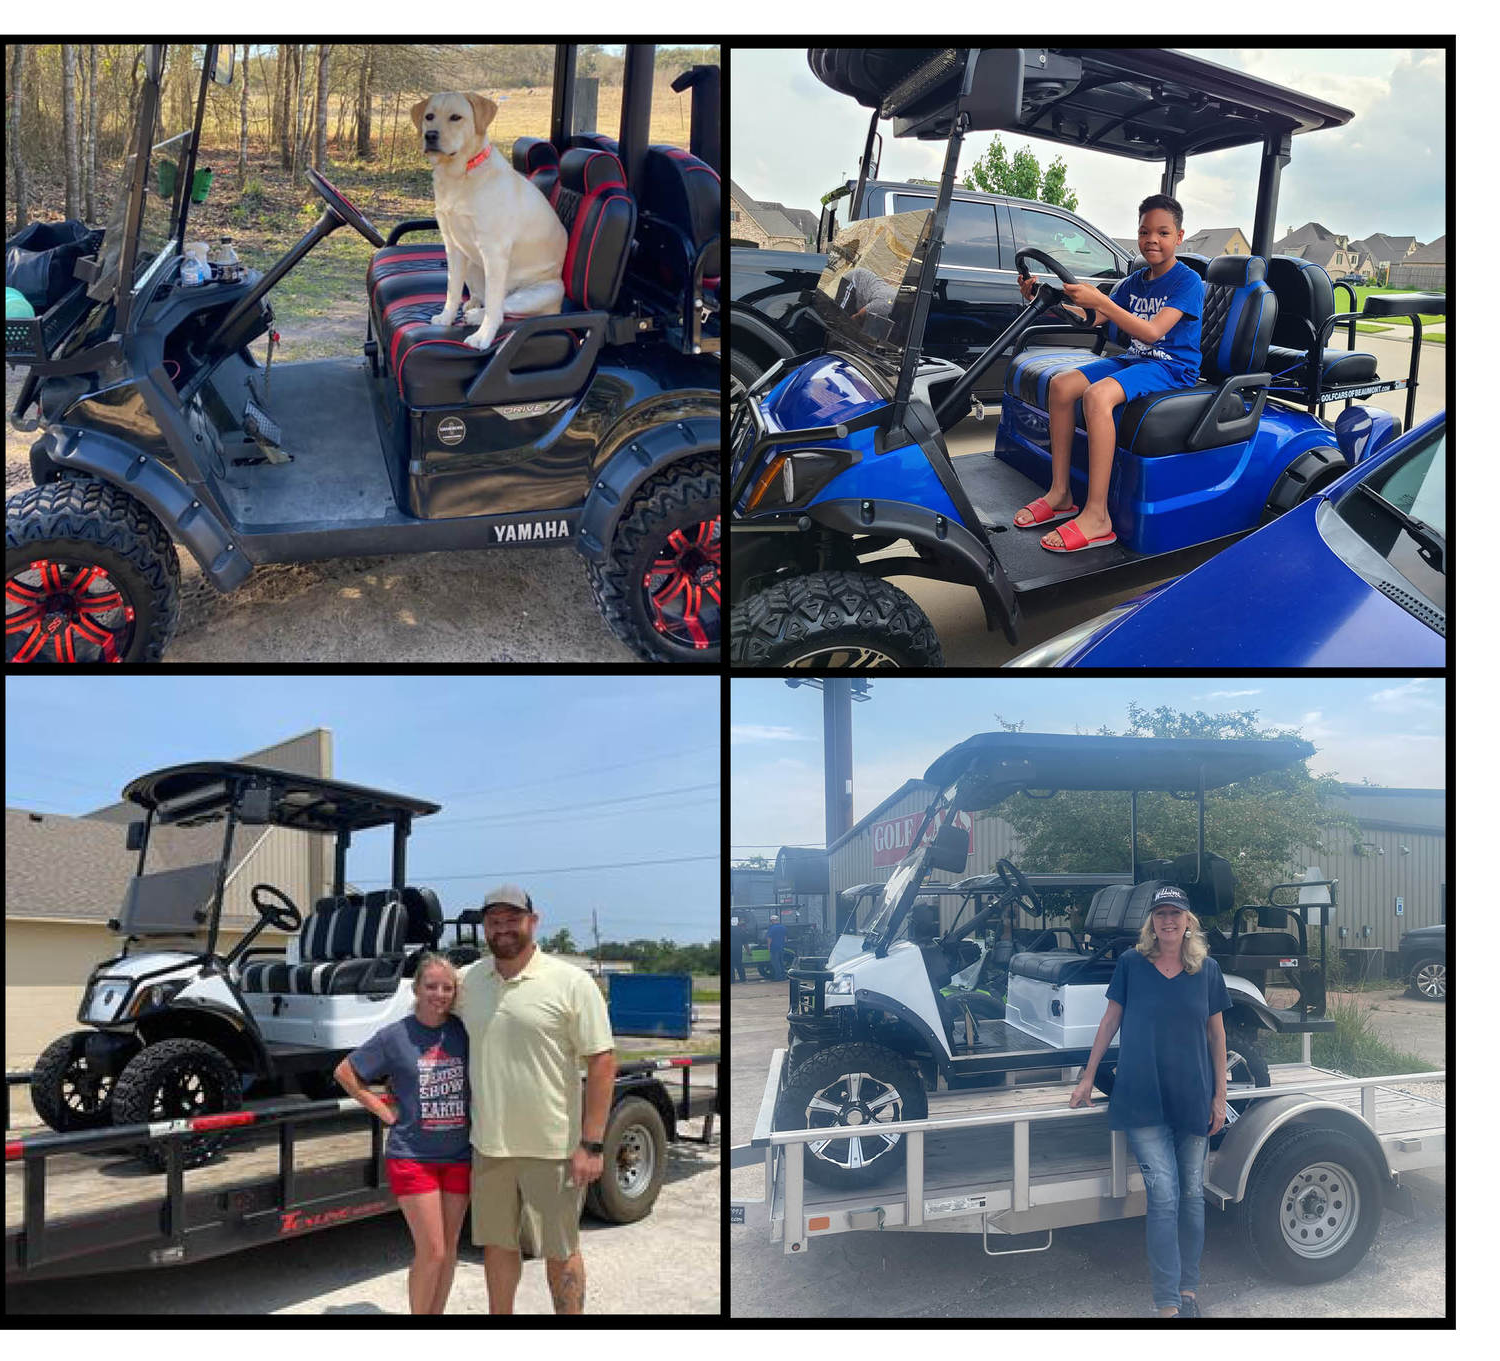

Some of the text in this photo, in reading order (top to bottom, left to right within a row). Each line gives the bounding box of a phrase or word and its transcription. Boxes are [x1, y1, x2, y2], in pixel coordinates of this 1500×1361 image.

[494, 519, 570, 542] YAMAHA
[874, 818, 915, 853] GOLF
[421, 1100, 466, 1119] EARTH
